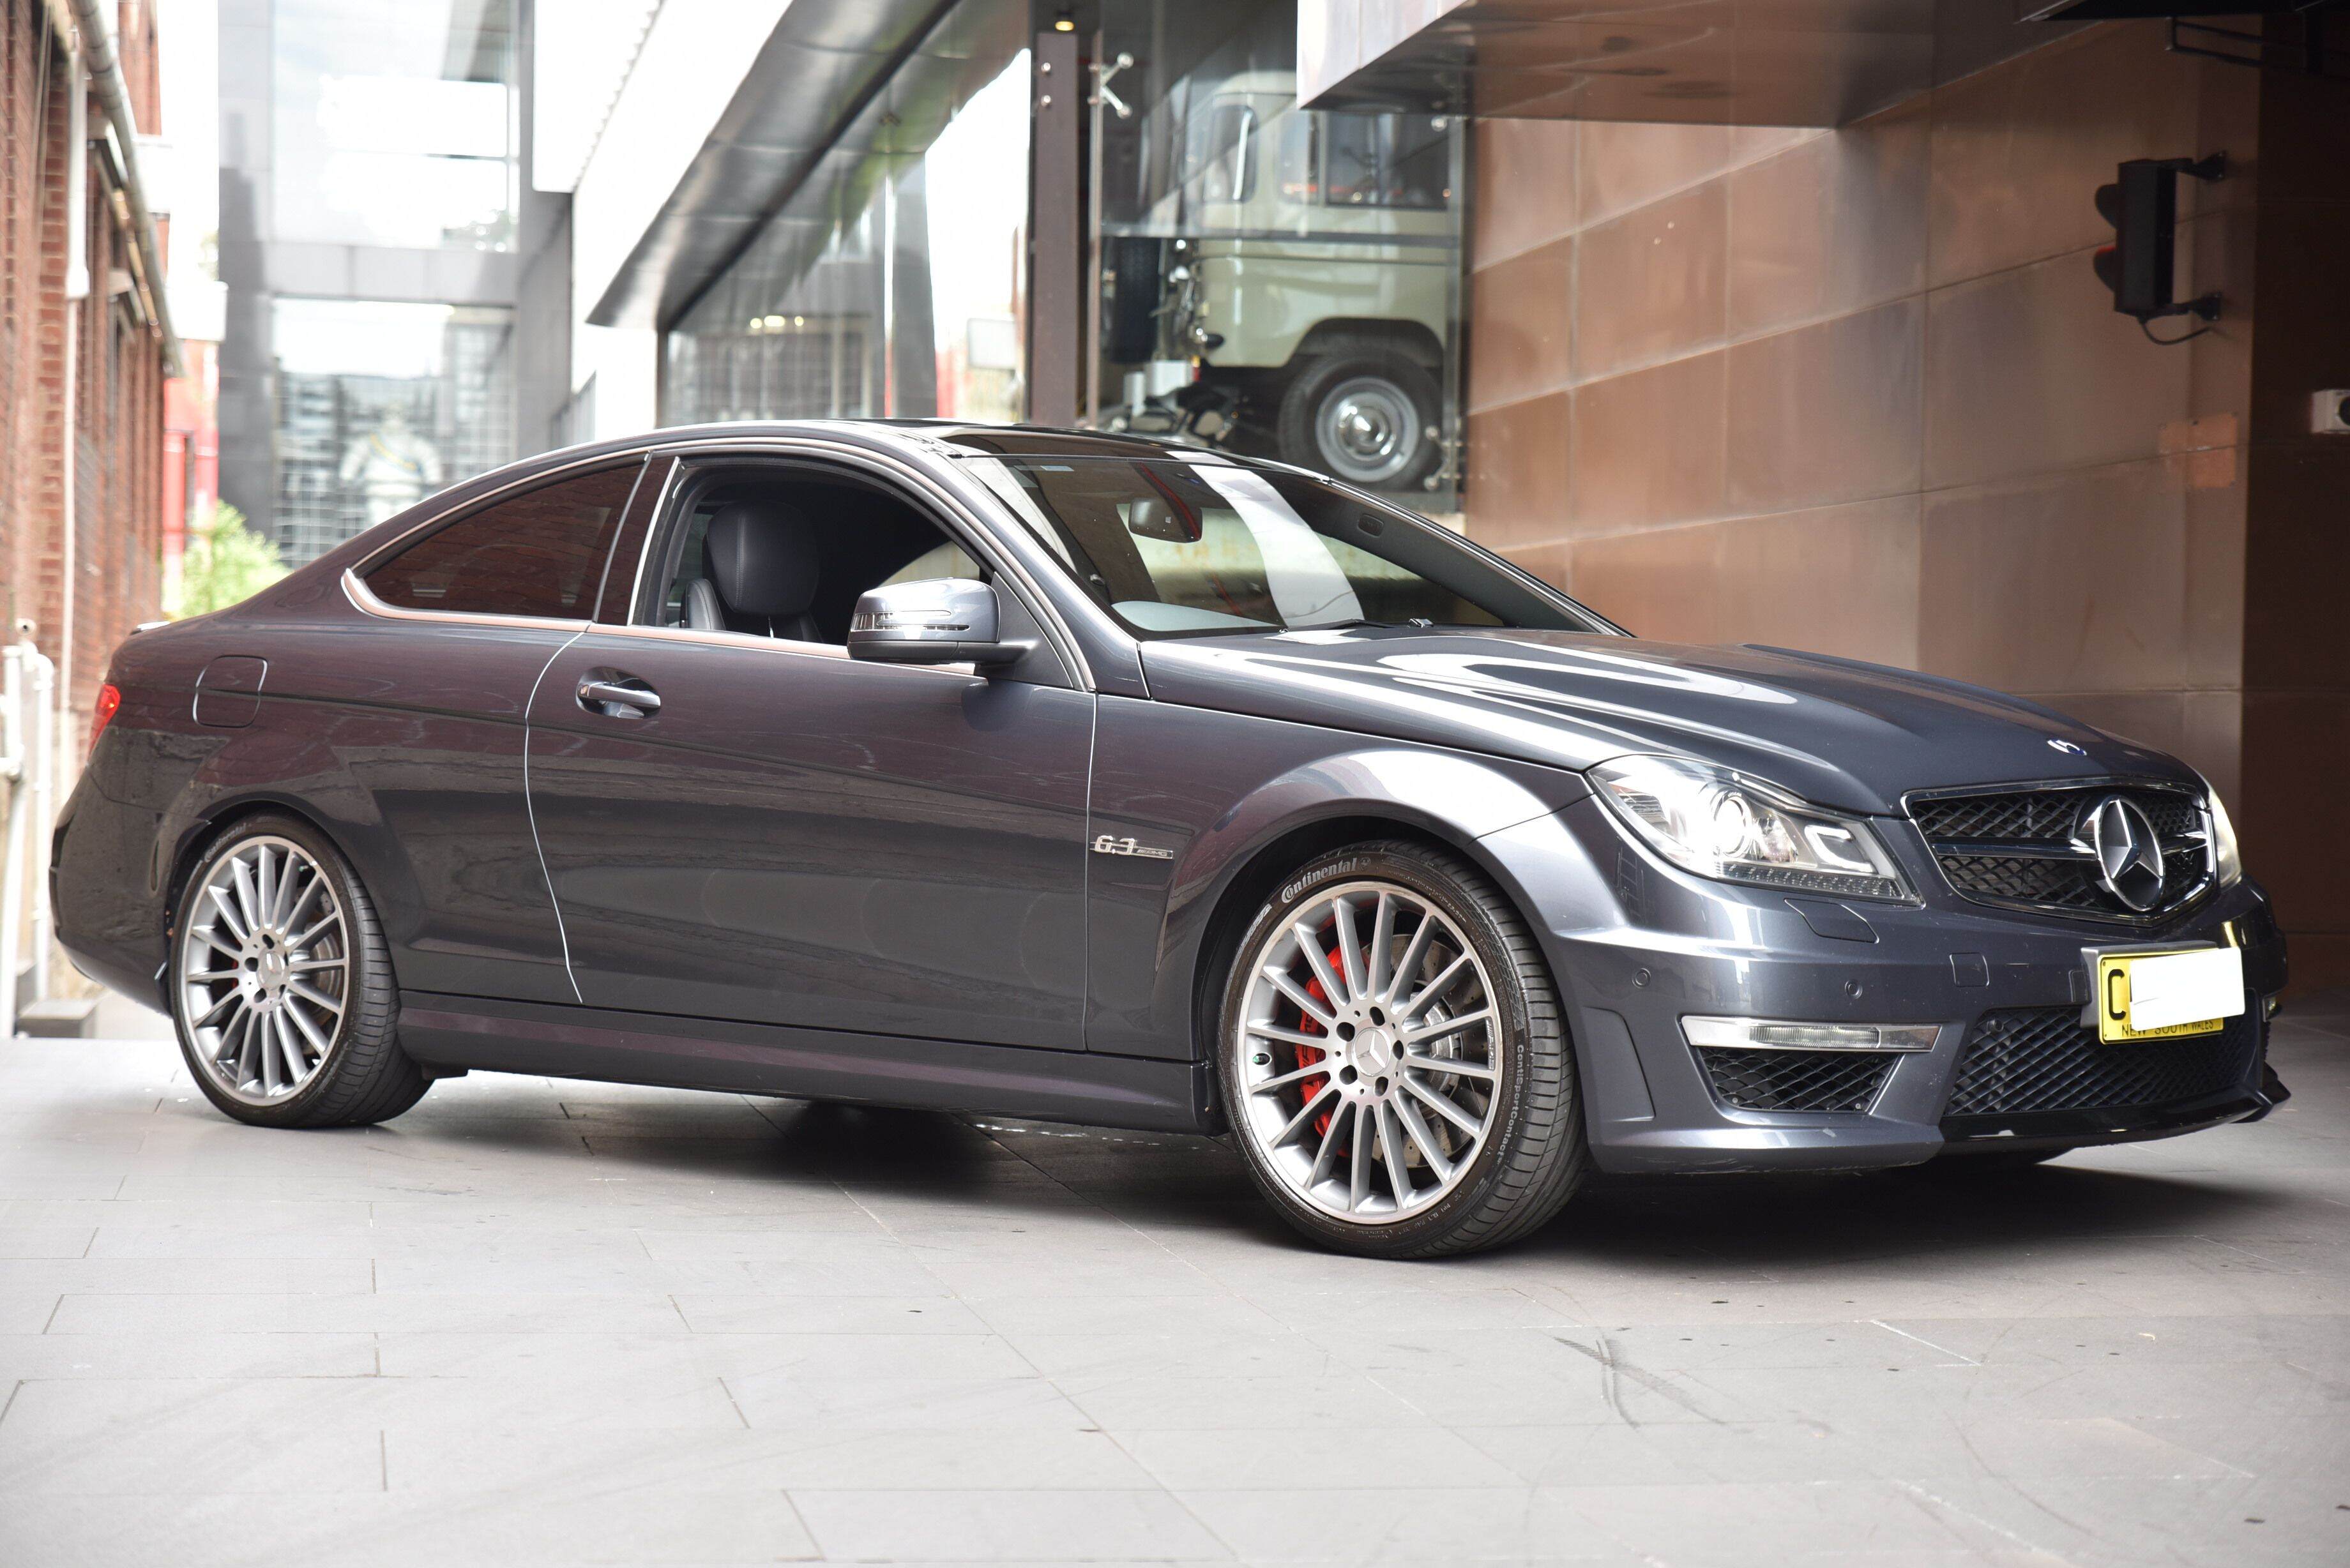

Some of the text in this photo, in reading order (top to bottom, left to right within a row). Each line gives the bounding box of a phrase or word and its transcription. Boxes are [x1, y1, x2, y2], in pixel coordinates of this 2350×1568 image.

[1095, 835, 1135, 856] 6.3
[1281, 857, 1358, 903] Continental
[2107, 969, 2132, 1020] C
[2190, 1021, 2214, 1030] WALES
[1497, 1044, 1524, 1156] ContiSportContact
